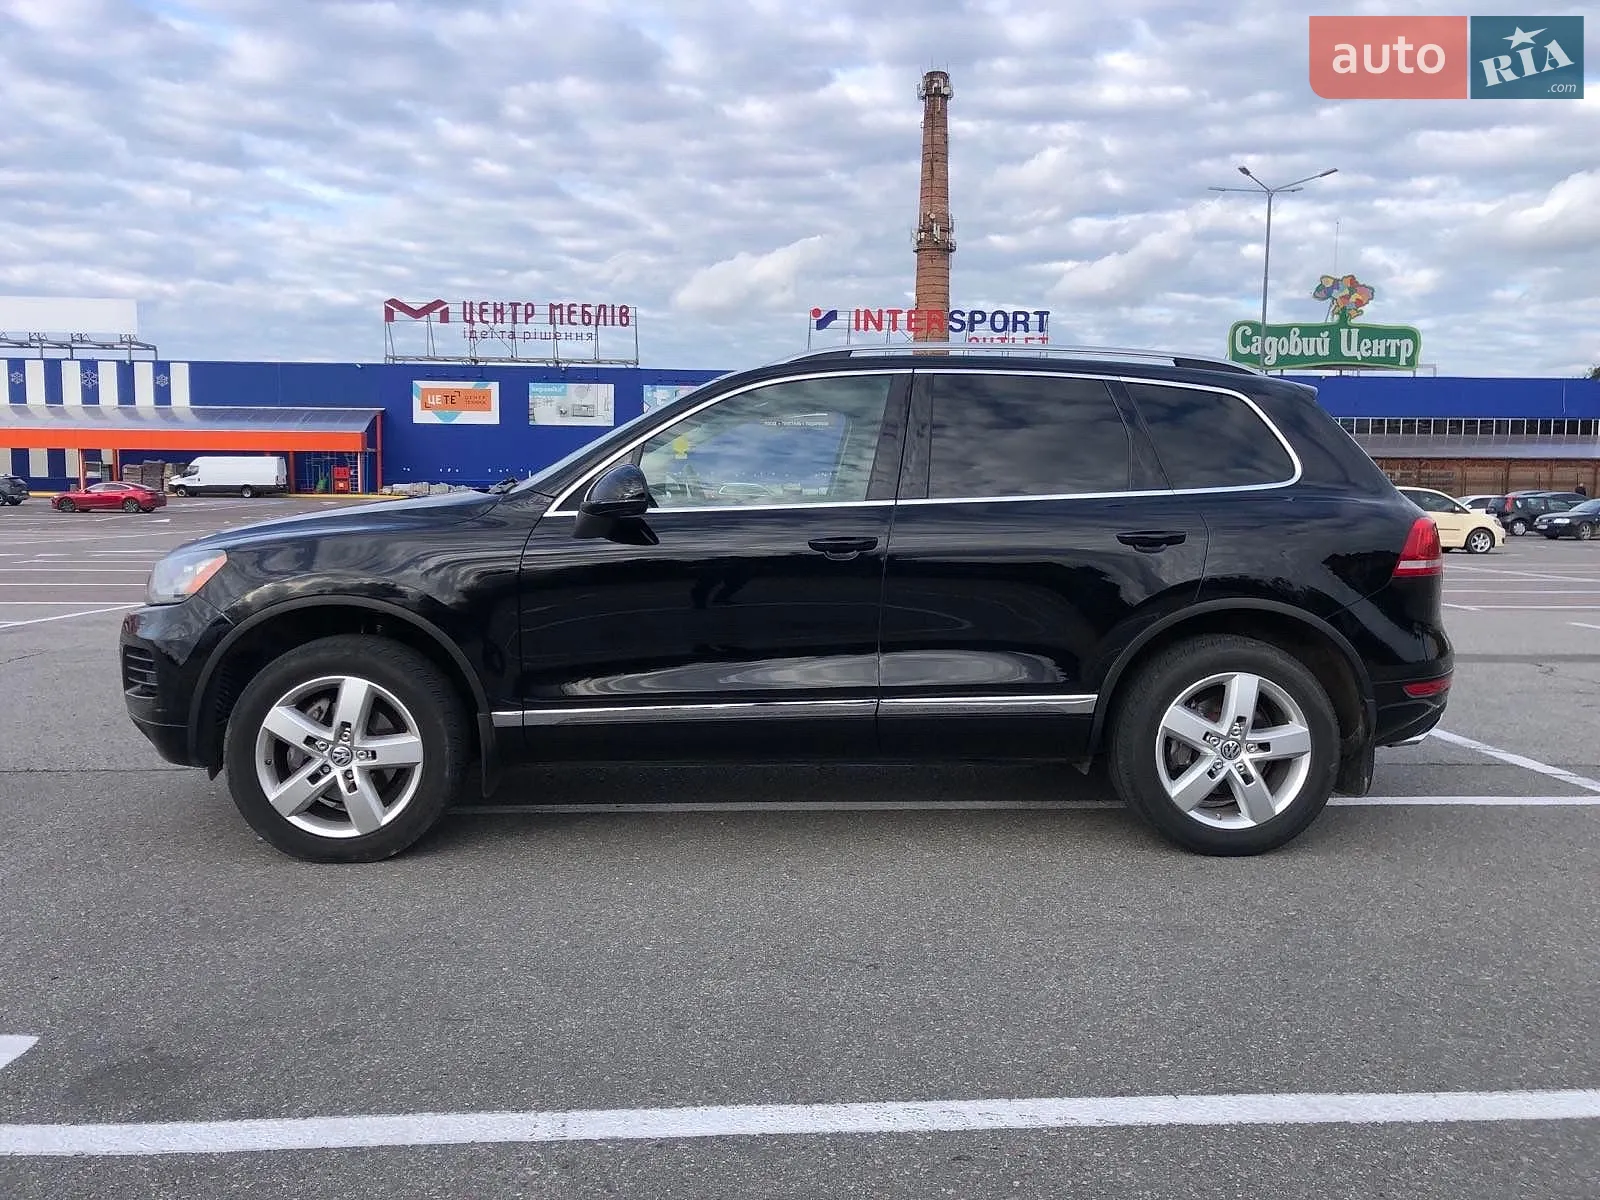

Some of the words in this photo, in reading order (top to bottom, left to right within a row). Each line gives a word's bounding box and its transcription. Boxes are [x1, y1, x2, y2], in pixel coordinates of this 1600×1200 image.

[462, 301, 535, 326] ЦЕНТР
[549, 302, 630, 327] МЕБЛІВ
[854, 308, 1050, 333] INTERSPORT
[500, 330, 516, 340] та
[523, 328, 593, 343] рішення
[1235, 325, 1330, 365] Садовий
[1340, 328, 1414, 365] Центр
